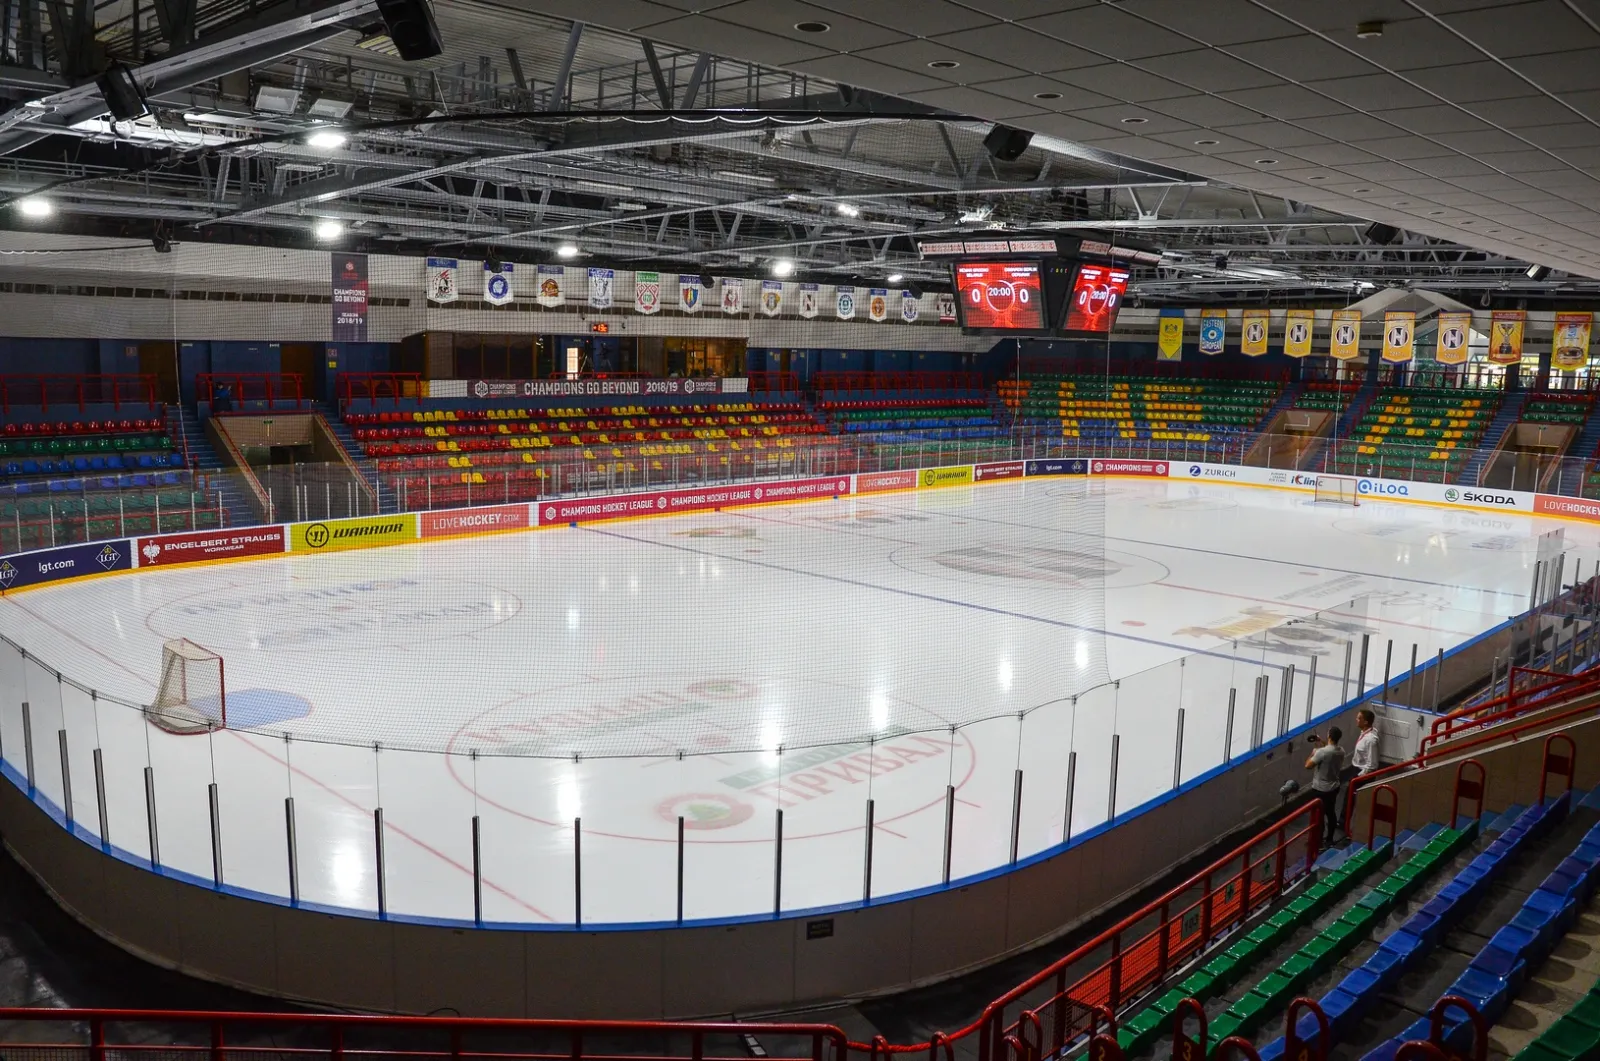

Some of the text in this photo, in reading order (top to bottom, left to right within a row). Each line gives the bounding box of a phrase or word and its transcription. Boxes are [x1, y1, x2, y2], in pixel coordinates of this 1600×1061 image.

[333, 288, 366, 297] CHAMPIONS
[972, 288, 981, 303] 0
[988, 287, 1011, 297] 20:00
[1020, 288, 1029, 303] 0
[337, 317, 363, 325] 2018/19
[524, 381, 678, 395] CHAMPIONS GO BEYOND 2018/19
[1105, 463, 1141, 472] CHAMPIONS
[1204, 468, 1236, 477] ZURICH
[766, 483, 835, 497] CHAMPIONS HOCKEY LEAGUE
[1374, 482, 1409, 496] iLOQ
[671, 490, 751, 506] CHAMPIONS HOCKEY LEAGUE
[1463, 490, 1516, 506] ŠKODA
[561, 499, 654, 517] CHAMPIONS HOCKEY LEAGUE
[433, 513, 519, 530] LOVEHOCKEY.COM
[333, 523, 403, 539] WARRIOR
[164, 533, 281, 551] ENGELBERT STRAUSS
[204, 544, 244, 553] WORKWEAR
[100, 552, 118, 563] LGT
[38, 558, 75, 574] lgt.com
[745, 735, 963, 807] ПРИВАЛ
